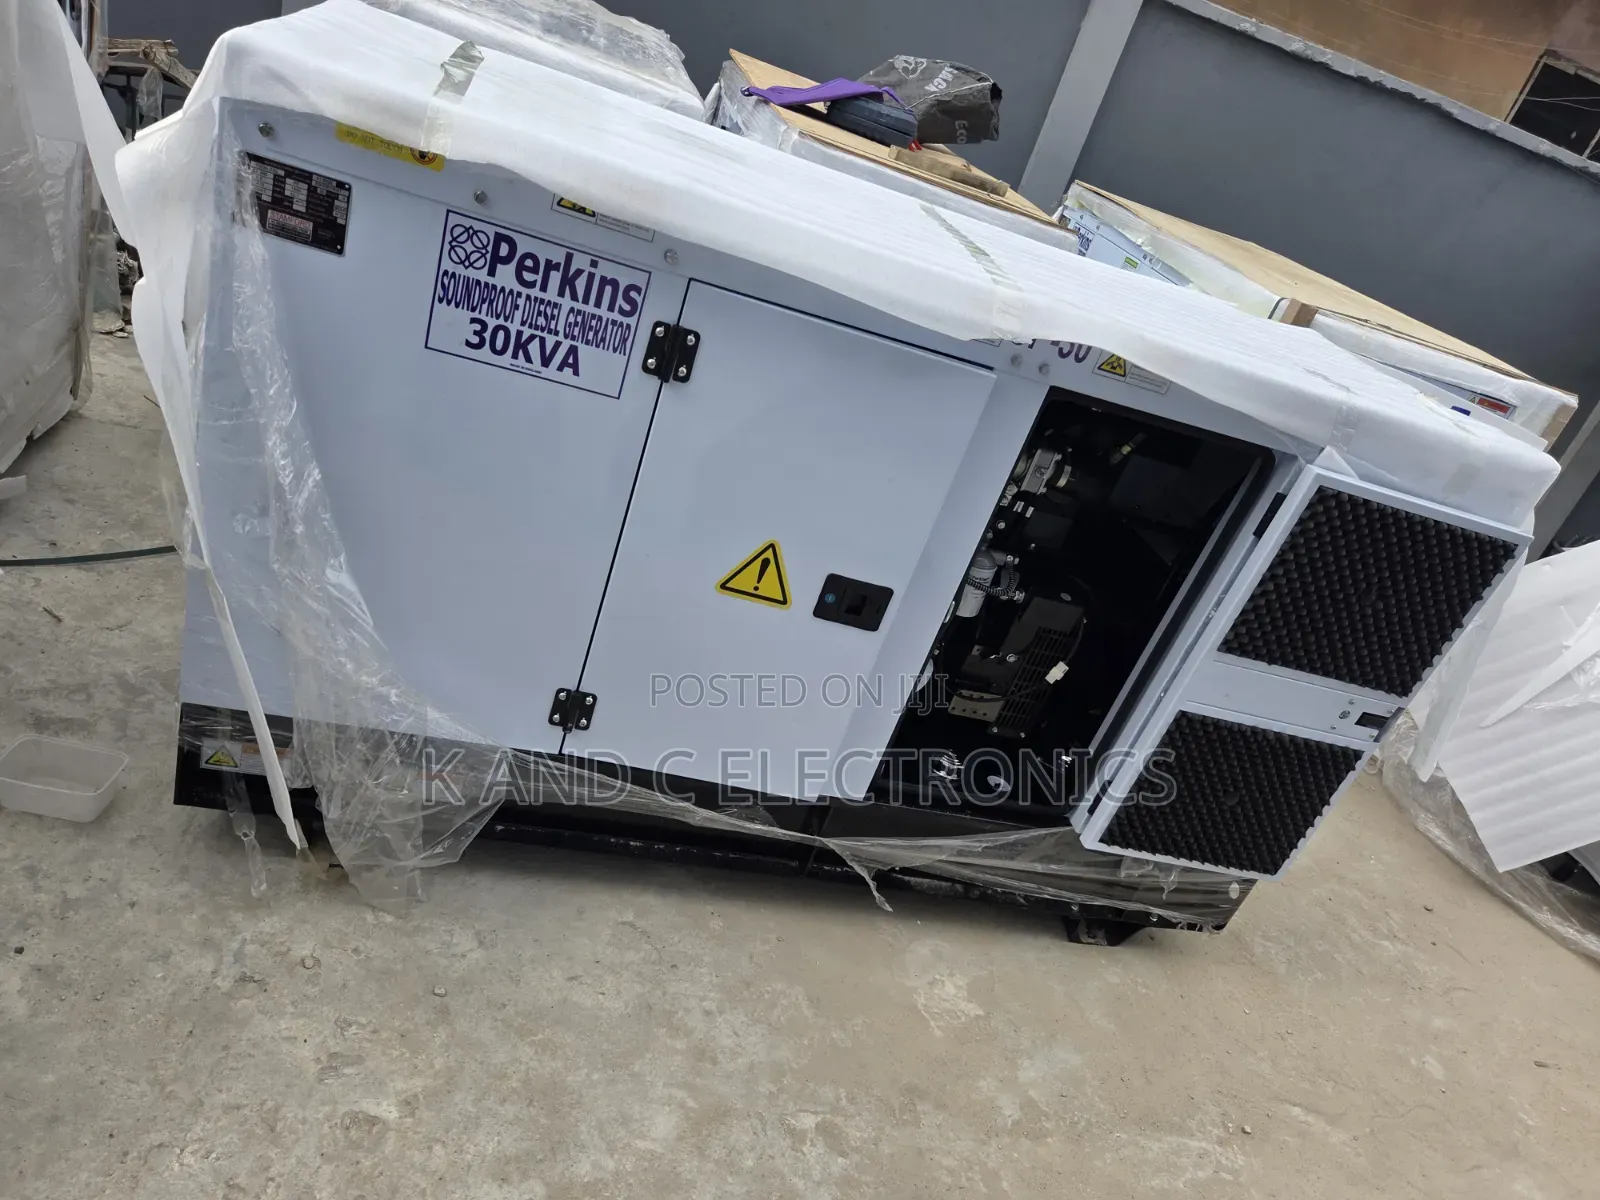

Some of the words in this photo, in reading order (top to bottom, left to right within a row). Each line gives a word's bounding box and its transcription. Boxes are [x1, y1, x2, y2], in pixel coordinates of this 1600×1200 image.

[437, 269, 522, 324] SOUNDPROOF
[520, 293, 563, 337] DIESEL
[563, 306, 632, 356] GENERATOR
[487, 231, 643, 318] Perkins
[464, 317, 580, 377] 30KVA
